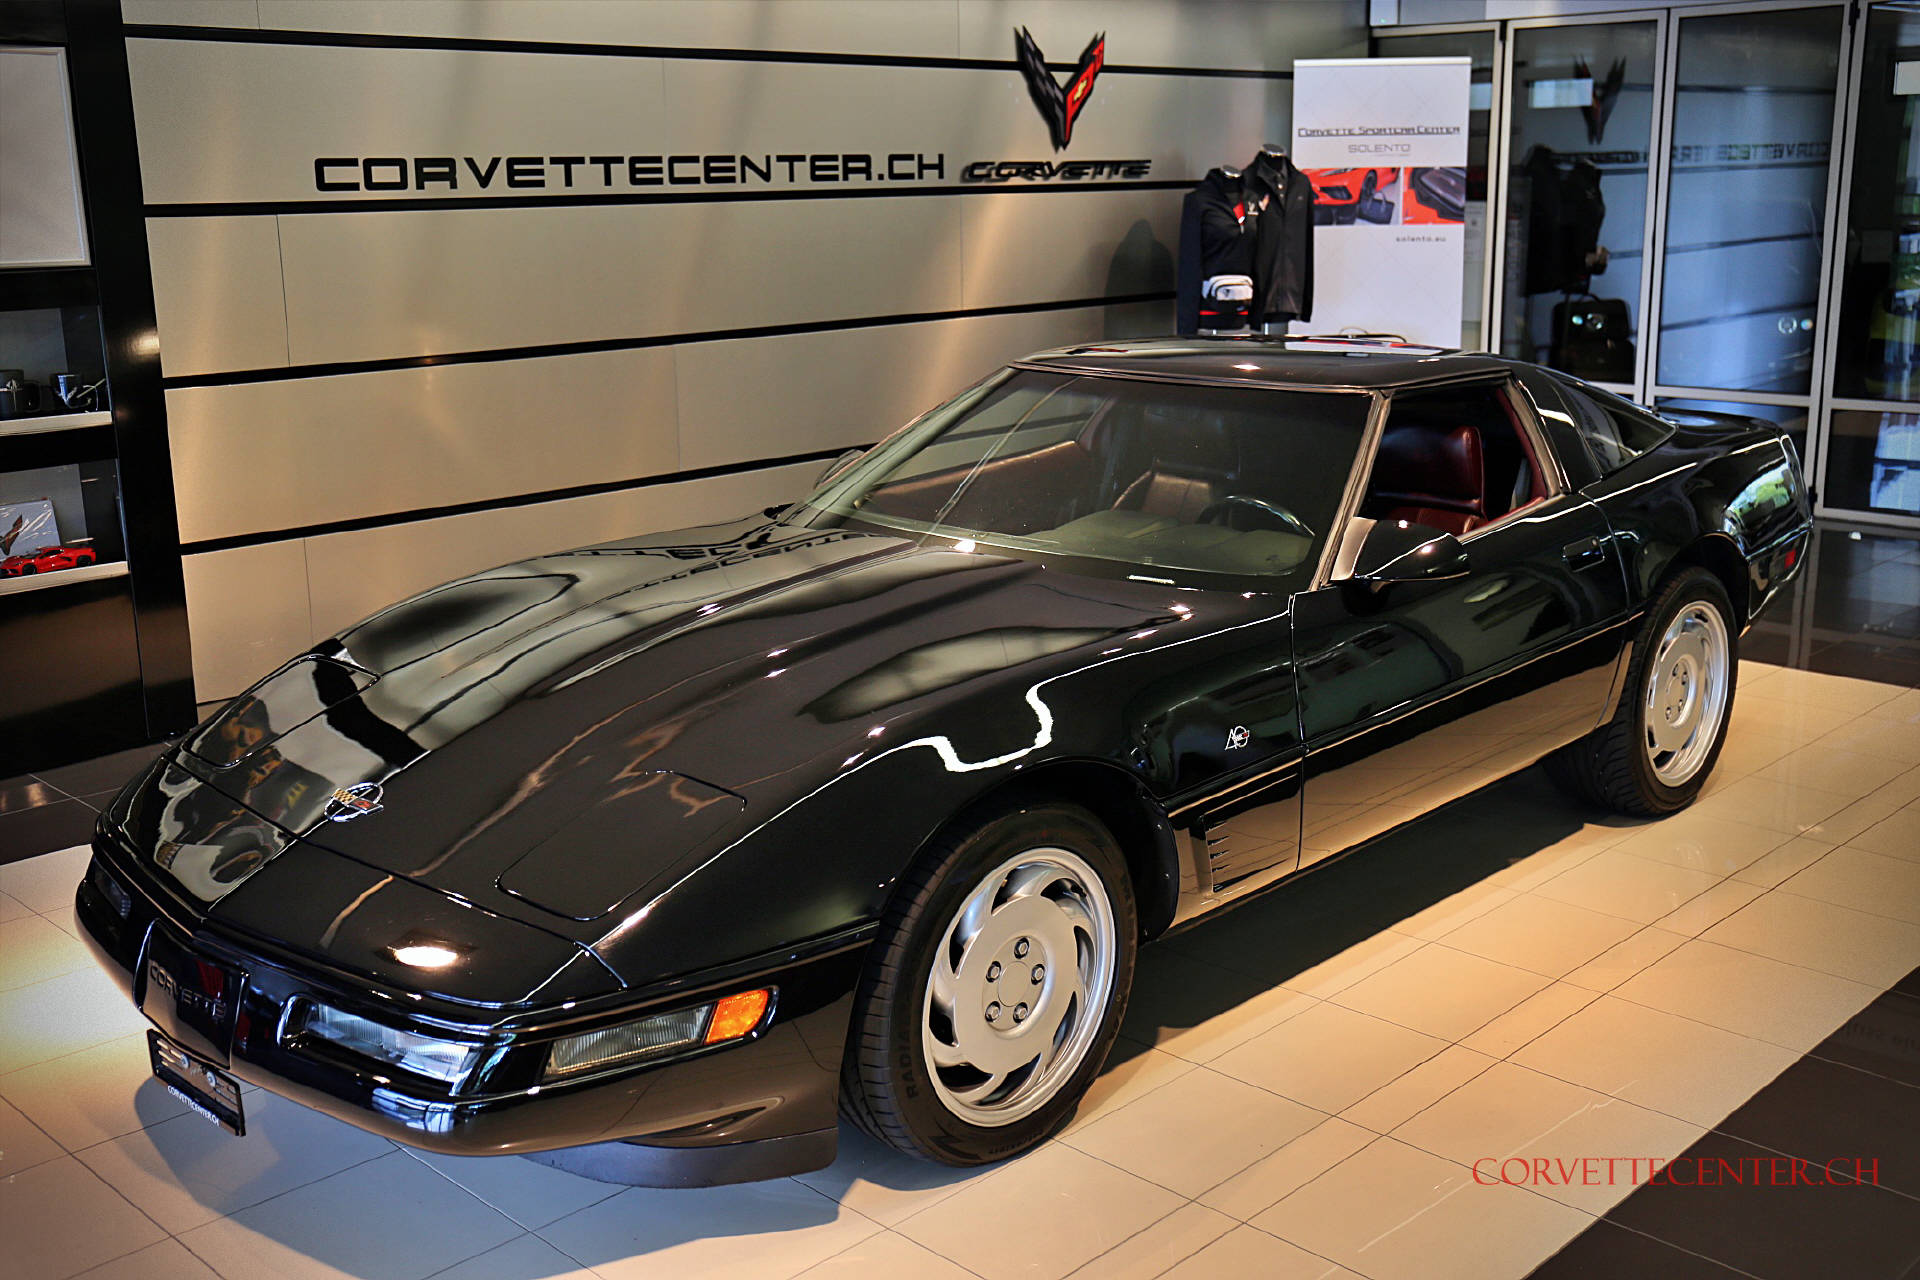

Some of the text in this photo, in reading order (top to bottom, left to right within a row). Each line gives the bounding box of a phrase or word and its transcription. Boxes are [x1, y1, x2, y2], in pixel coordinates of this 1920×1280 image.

[1348, 144, 1411, 153] SOLENTO
[314, 153, 945, 192] CORVETTECENTER.CH
[961, 159, 1152, 182] CORVETTE
[150, 960, 227, 1021] CORVETTE
